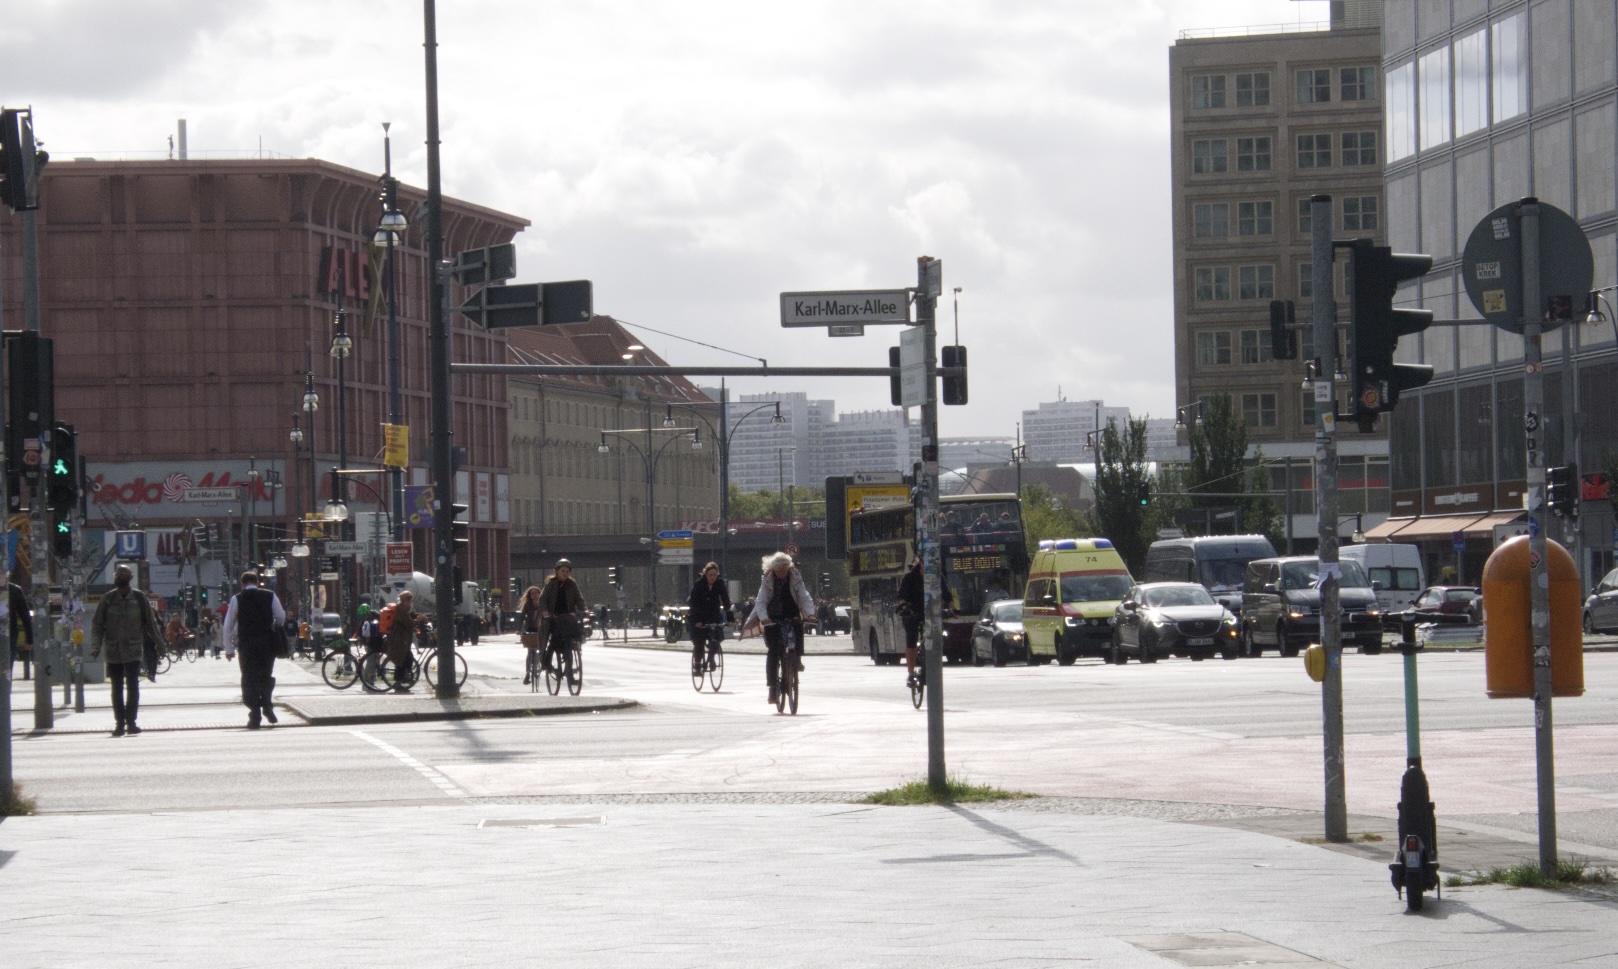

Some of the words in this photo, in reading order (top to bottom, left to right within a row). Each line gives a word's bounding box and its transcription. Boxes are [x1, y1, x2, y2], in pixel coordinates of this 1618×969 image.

[1478, 270, 1497, 278] KREK
[794, 299, 897, 317] Karl-Marx-Allee
[188, 491, 232, 499] Karl-Marx-Allee
[680, 521, 719, 533] KFC
[123, 534, 137, 551] U
